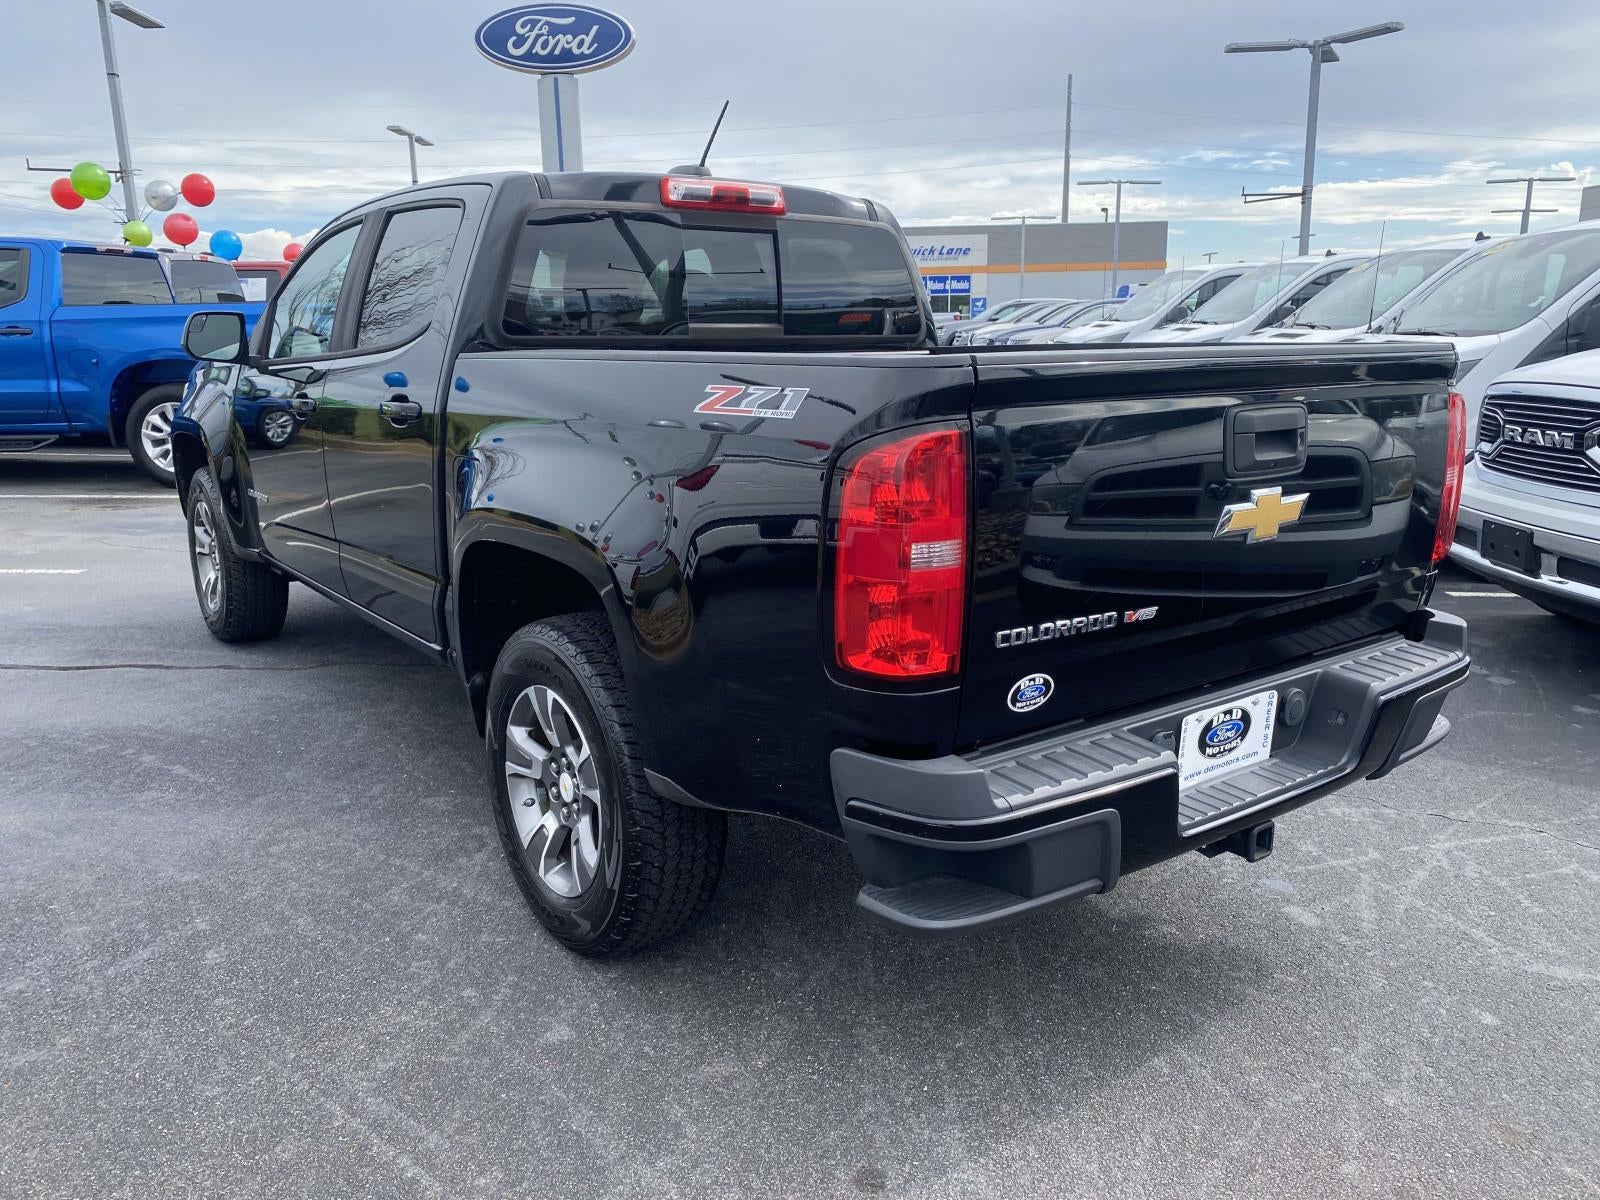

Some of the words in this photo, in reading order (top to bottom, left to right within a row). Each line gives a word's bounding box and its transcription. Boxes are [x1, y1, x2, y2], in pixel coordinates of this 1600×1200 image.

[507, 15, 600, 57] Ford
[911, 245, 936, 256] uick
[938, 245, 971, 256] Lane
[951, 280, 970, 290] Models
[693, 384, 811, 413] Z71
[753, 409, 769, 417] OFF
[770, 410, 795, 418] ROAD
[1503, 424, 1575, 450] RAM
[994, 611, 1118, 649] COLORADO
[1124, 606, 1159, 623] V6
[1020, 677, 1044, 691] D&D
[1022, 687, 1041, 700] Ford
[1016, 695, 1045, 709] MOTORS
[1211, 708, 1243, 729] D&D
[1213, 724, 1238, 743] Ford
[1205, 736, 1242, 757] MOTORS
[1183, 750, 1259, 782] www.ddmotors.com
